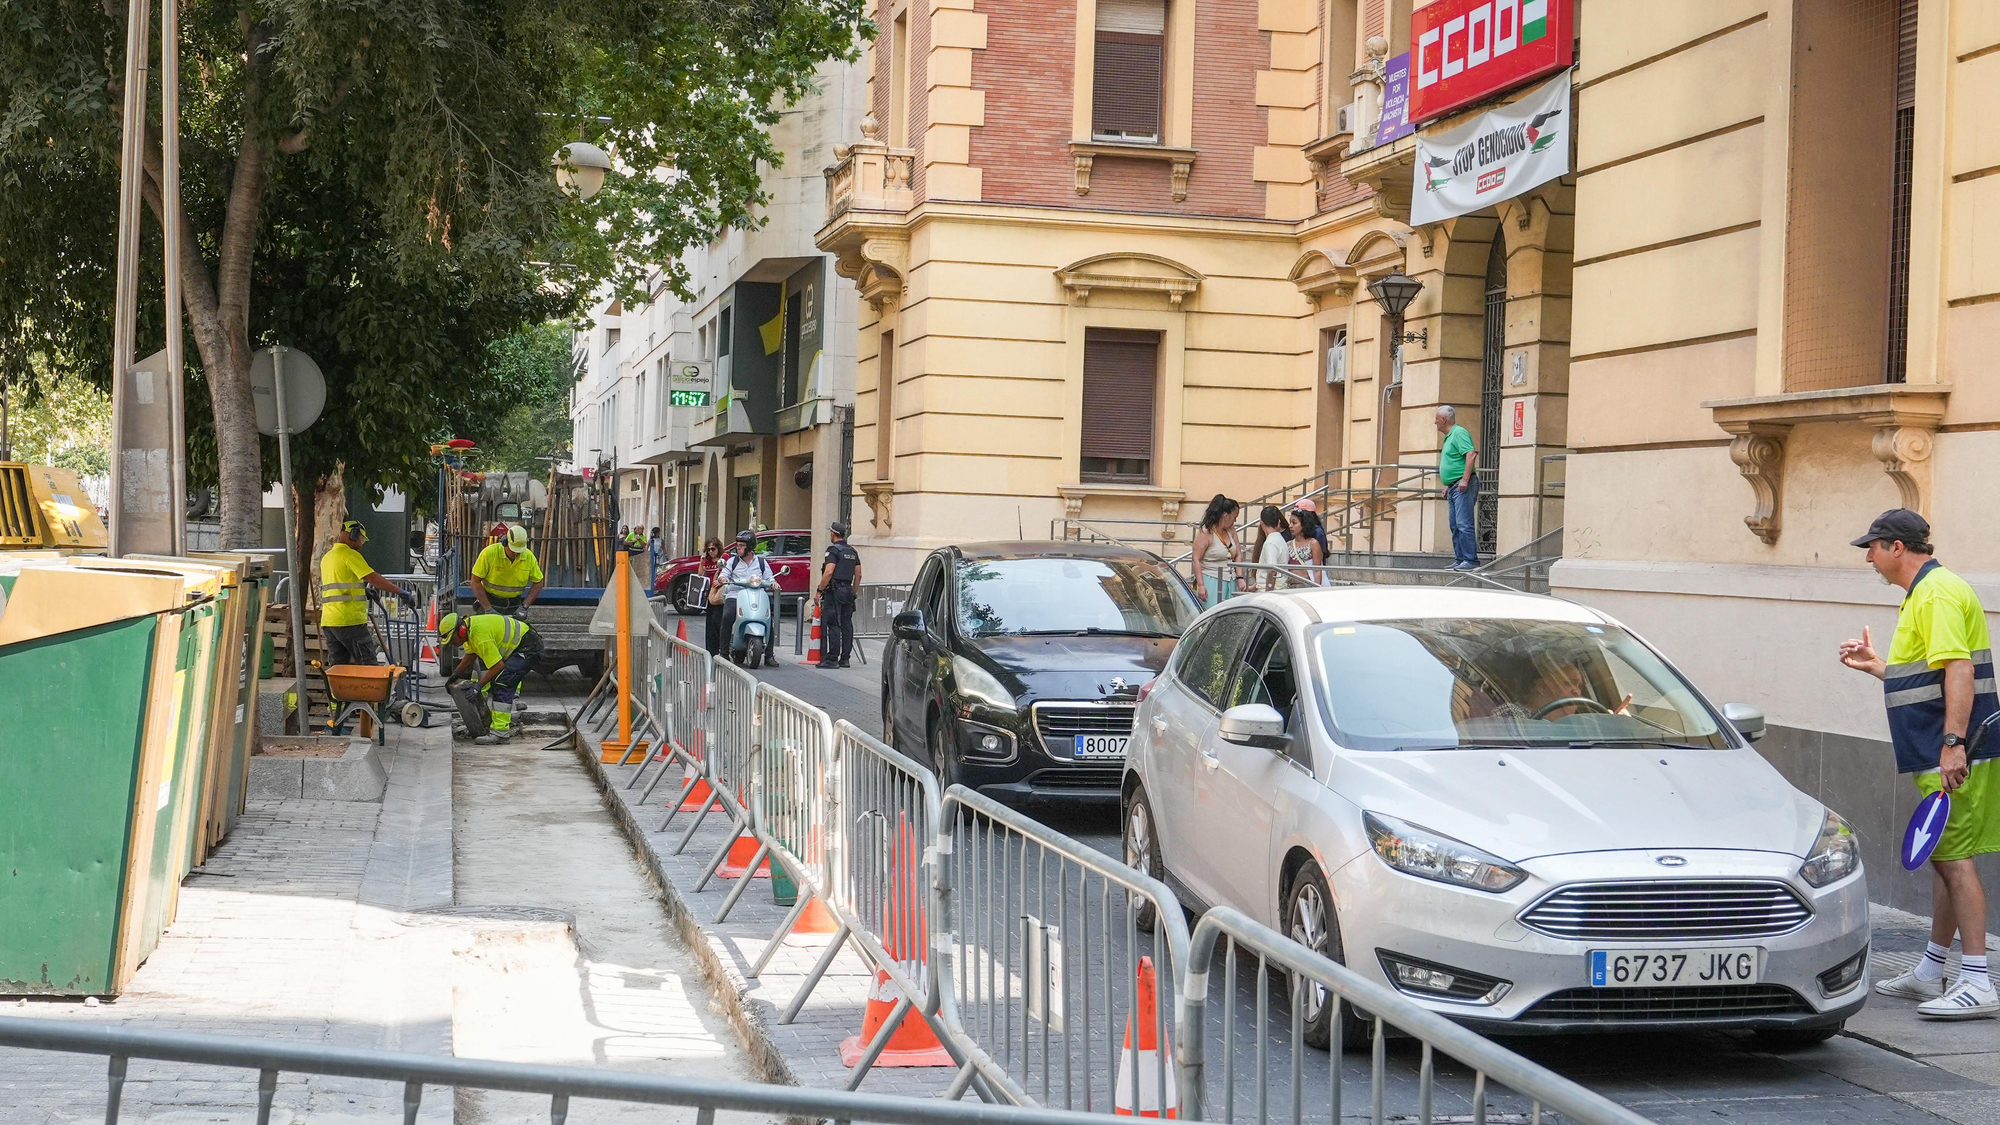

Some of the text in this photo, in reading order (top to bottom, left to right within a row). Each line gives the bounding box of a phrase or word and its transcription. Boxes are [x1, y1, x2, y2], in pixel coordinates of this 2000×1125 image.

[1418, 0, 1518, 90] CCOO
[1392, 83, 1401, 95] POR
[1453, 122, 1526, 176] STOP GENOCIDIO
[1477, 174, 1497, 191] CCOO
[672, 391, 706, 406] 11:57
[1086, 738, 1128, 753] 8007
[1613, 952, 1752, 983] 6737 JKG
